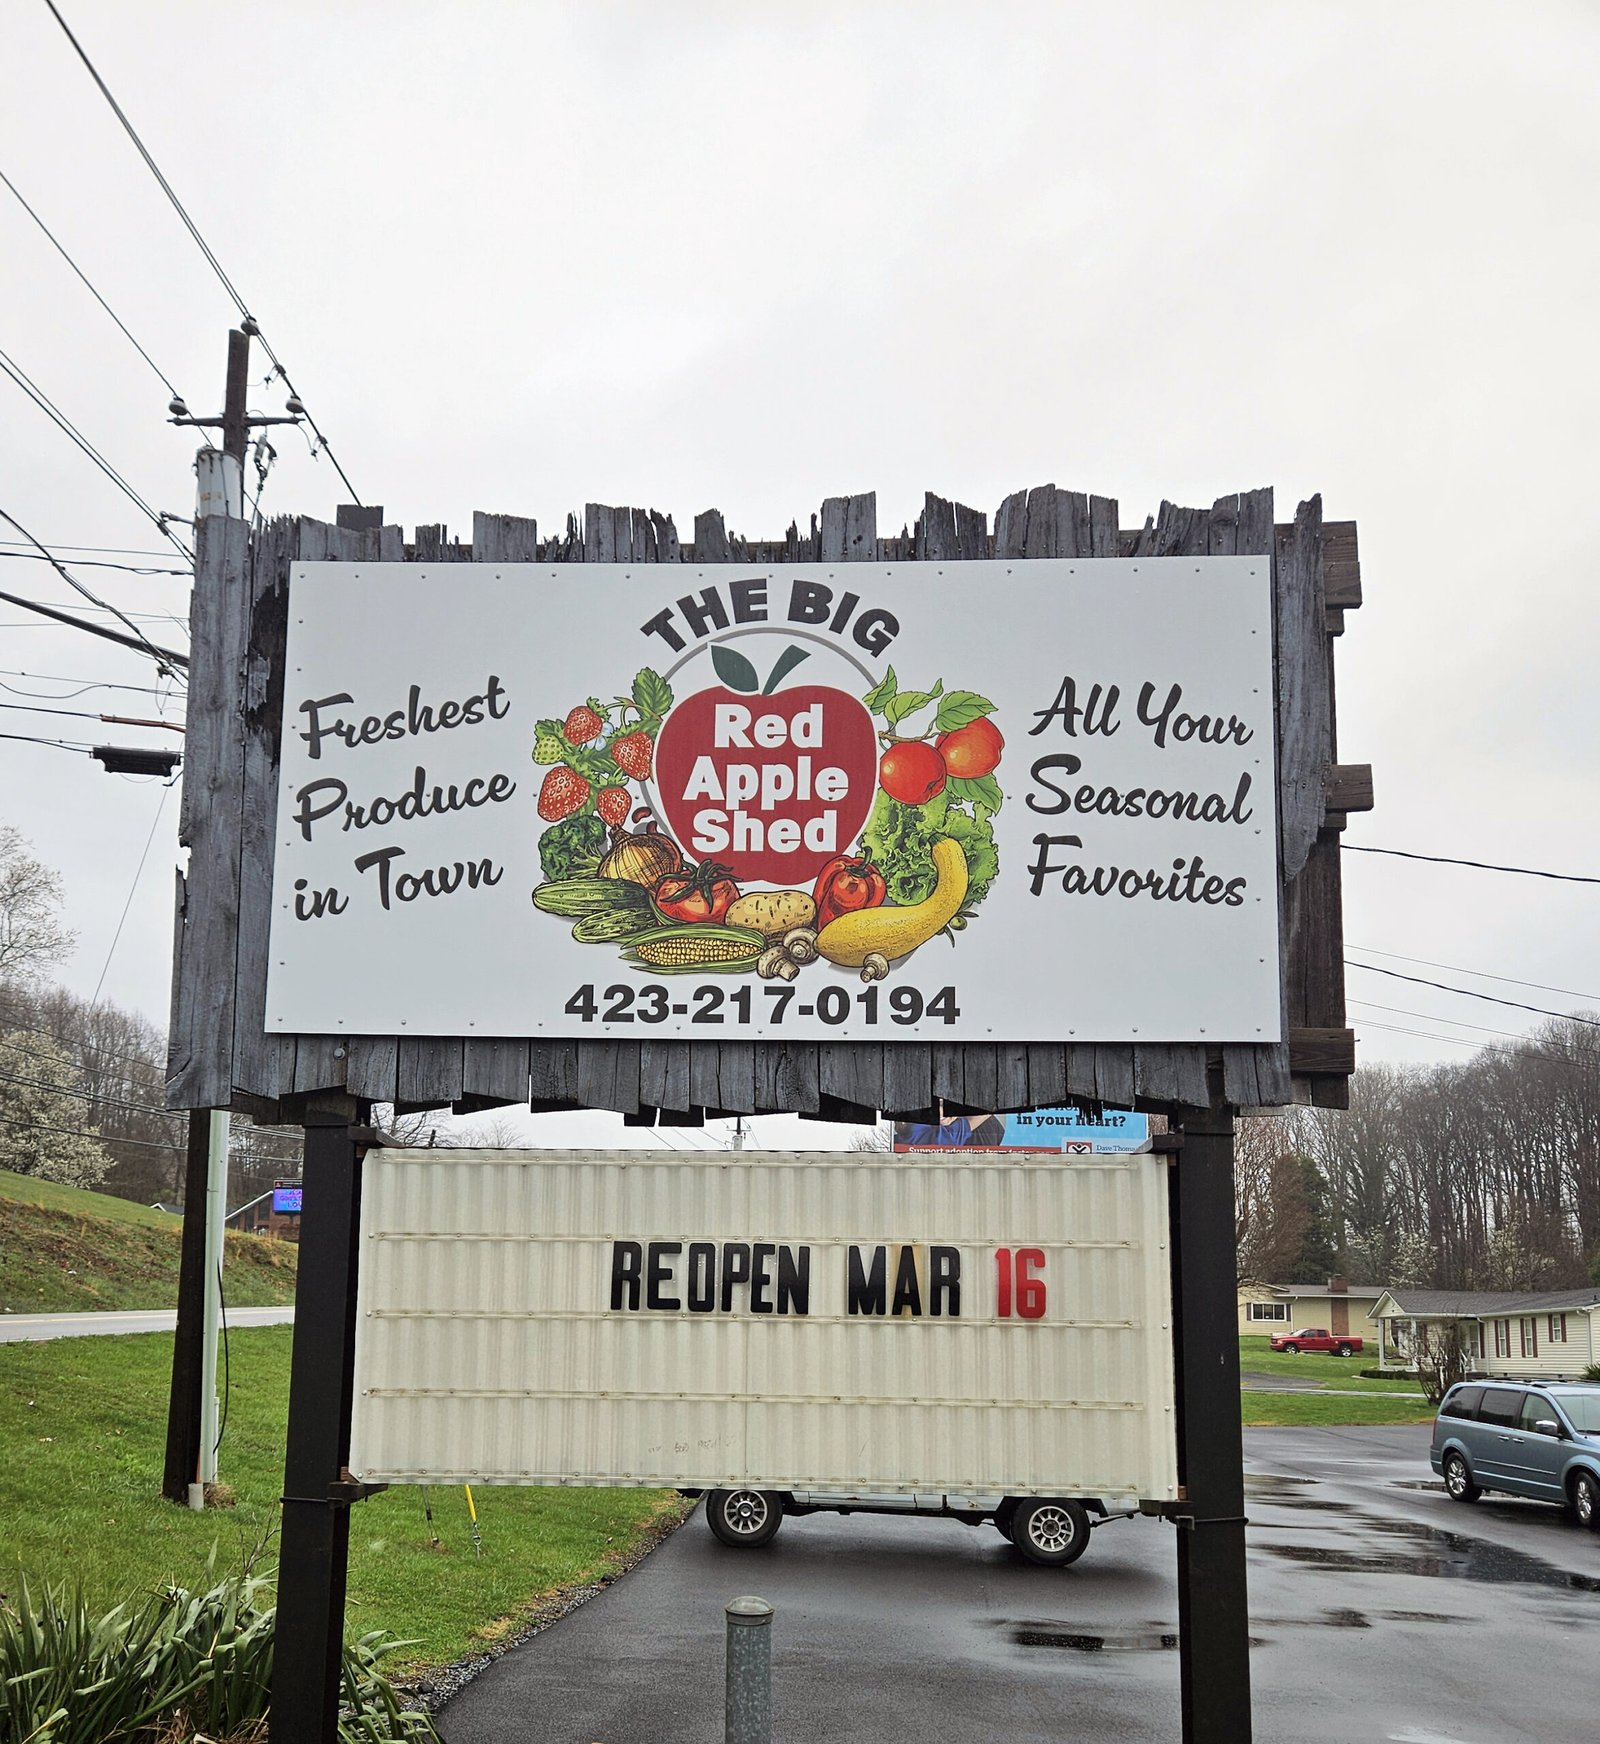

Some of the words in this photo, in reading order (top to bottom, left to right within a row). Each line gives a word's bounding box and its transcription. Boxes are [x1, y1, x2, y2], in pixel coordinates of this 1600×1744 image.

[640, 578, 768, 653] THE
[787, 579, 900, 658] BIG
[299, 675, 510, 759] Freshest
[714, 703, 823, 748] Red
[1028, 676, 1120, 737] All
[1137, 681, 1253, 748] Your
[292, 766, 516, 841] Produce
[682, 755, 848, 810] Apple
[1025, 753, 1252, 824] Seasonal
[692, 809, 837, 853] Shed
[294, 879, 349, 921] in
[354, 846, 503, 910] Town
[1027, 833, 1246, 906] Favorites
[564, 984, 960, 1025] 423-217-0194
[1016, 1113, 1032, 1125] in
[1035, 1116, 1072, 1127] your
[611, 1240, 810, 1315] REOPEN
[848, 1245, 960, 1316] MAR
[995, 1247, 1046, 1319] 16
